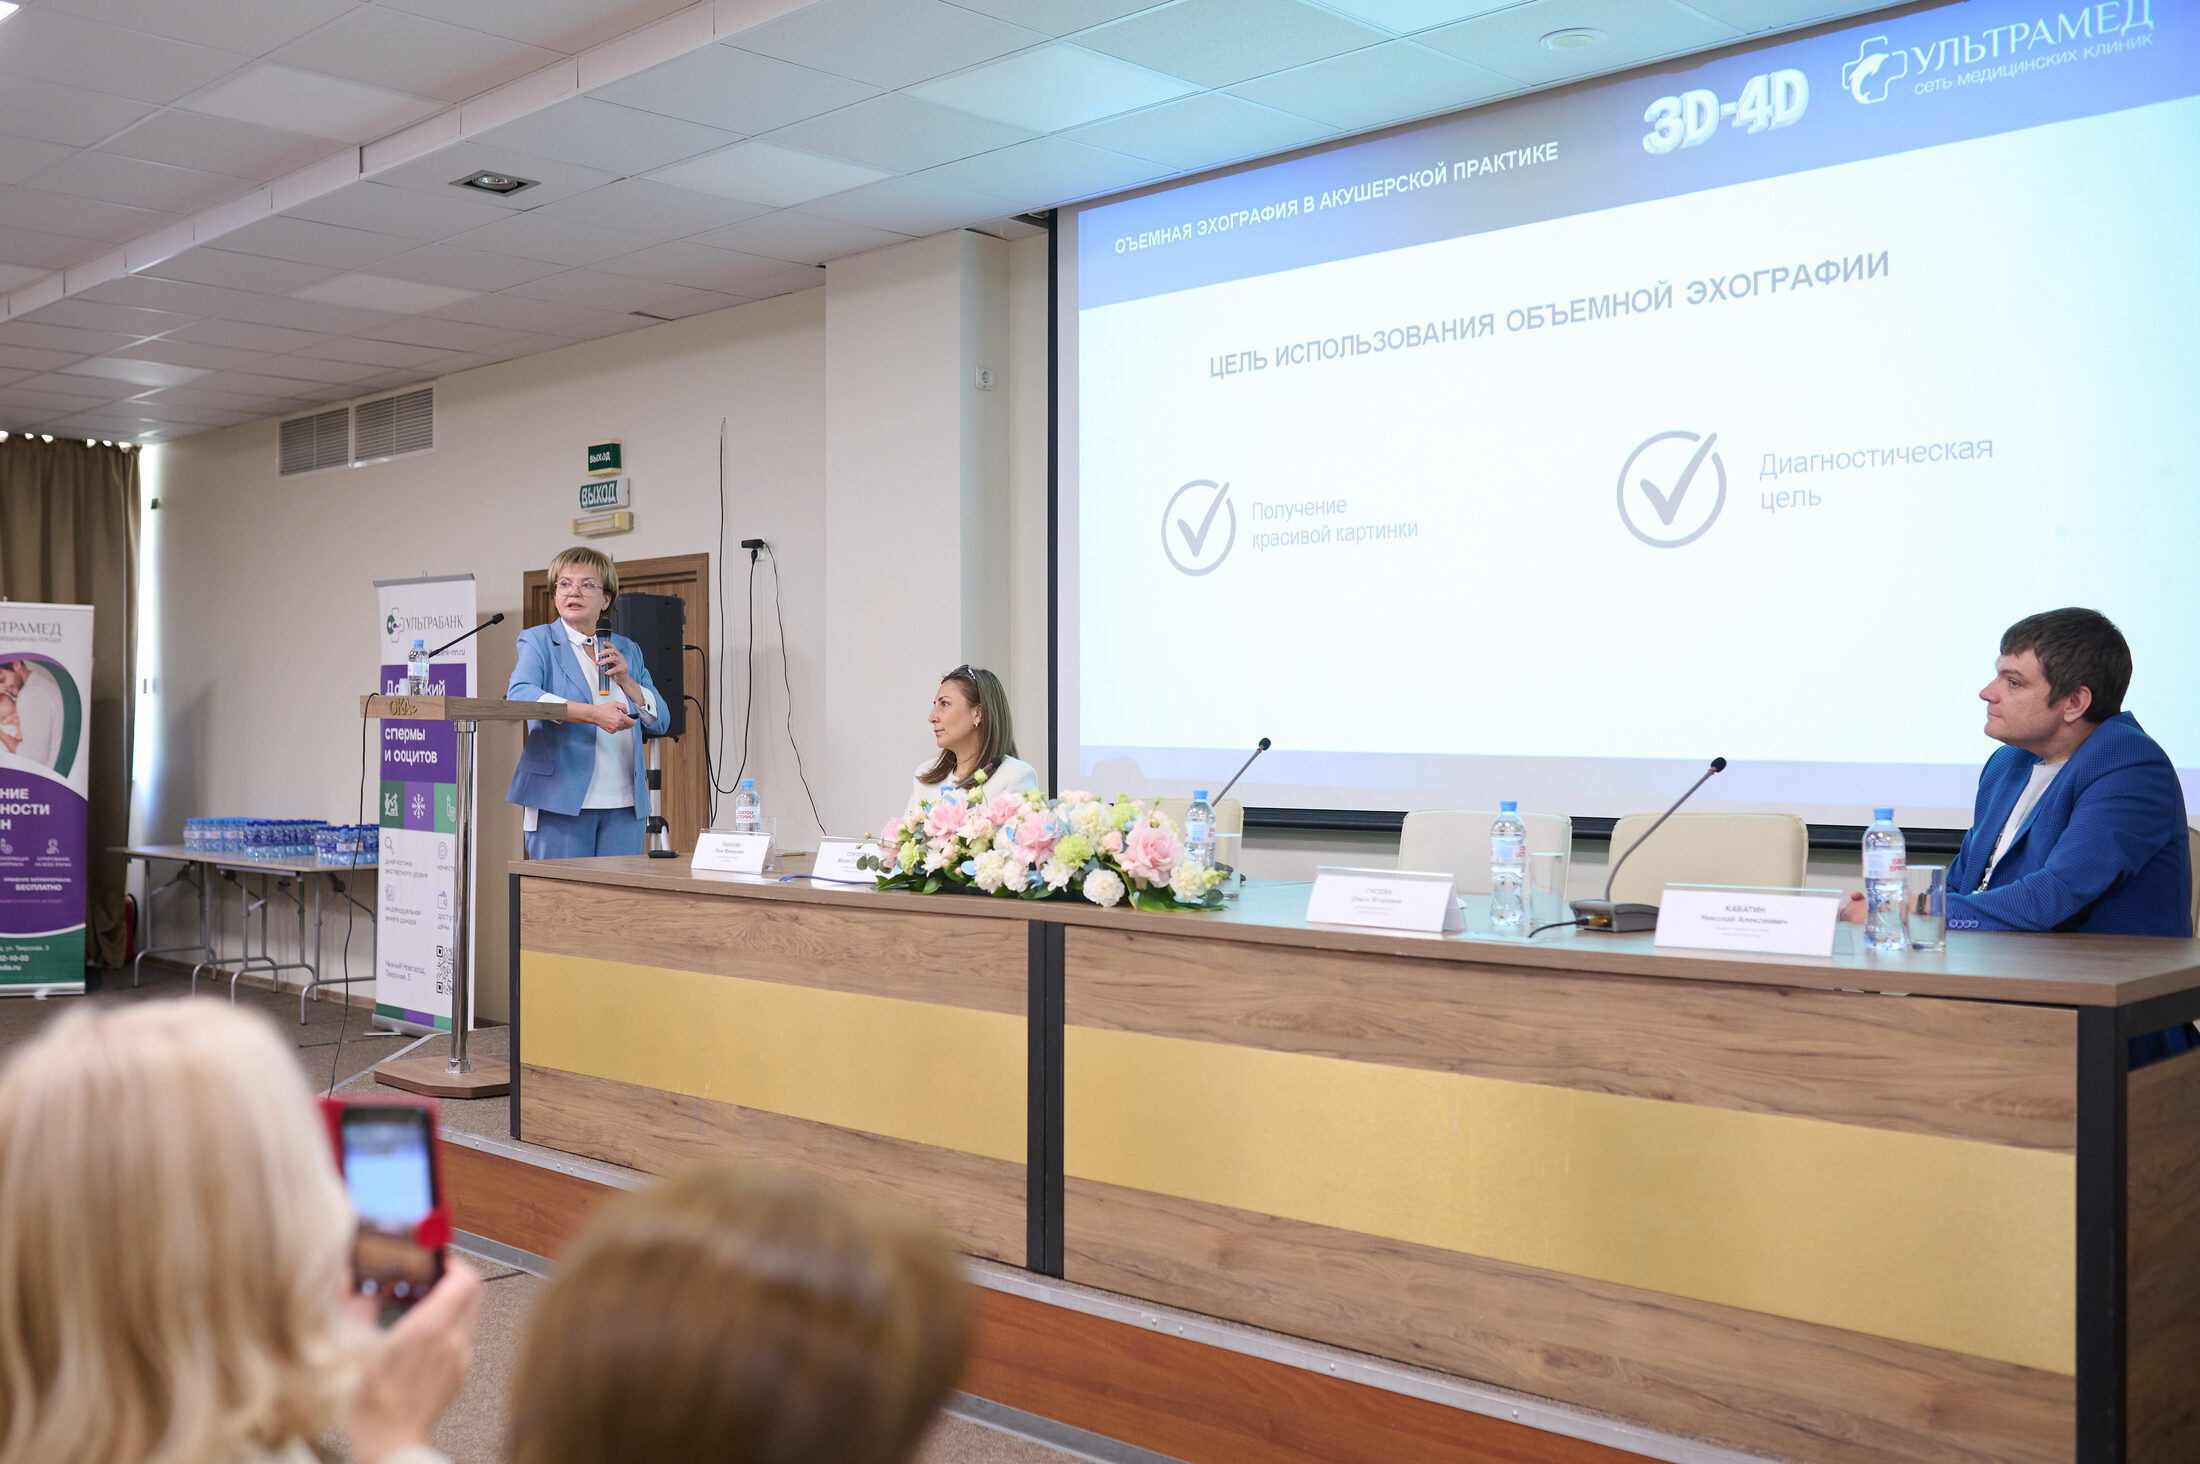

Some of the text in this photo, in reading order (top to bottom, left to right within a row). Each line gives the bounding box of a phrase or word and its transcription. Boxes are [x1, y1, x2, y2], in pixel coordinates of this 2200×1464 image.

[1911, 0, 2154, 75] УЛЬТРАМЕД
[1914, 33, 2153, 95] сеть медицинских клиник
[1643, 68, 1809, 155] 3D-4D
[1114, 141, 1559, 254] ОЪЕМНАЯ ЭХОГРАФИЯ В АКУШЕРСКОЙ ПРАКТИКЕ
[1210, 250, 1889, 379] ЦЕЛЬ ИСПОЛЬЗОВАНИЯ ОБЪЕМНОЙ ЭХОГРАФИИ
[1760, 439, 1993, 481] Диагностическая
[581, 482, 617, 506] ВЫХОД
[1761, 489, 1822, 514] цель
[1252, 499, 1347, 522] Получение
[1252, 522, 1418, 551] красивой картинки
[0, 621, 62, 637] ТРАМЕД
[404, 614, 464, 631] УЛЬТРАБАНК
[385, 680, 446, 696] Докий
[384, 727, 426, 744] спермы
[384, 750, 438, 767] и ооцитов
[0, 803, 51, 816] НОСТИ
[15, 883, 63, 892] БЕСПЛАТНО
